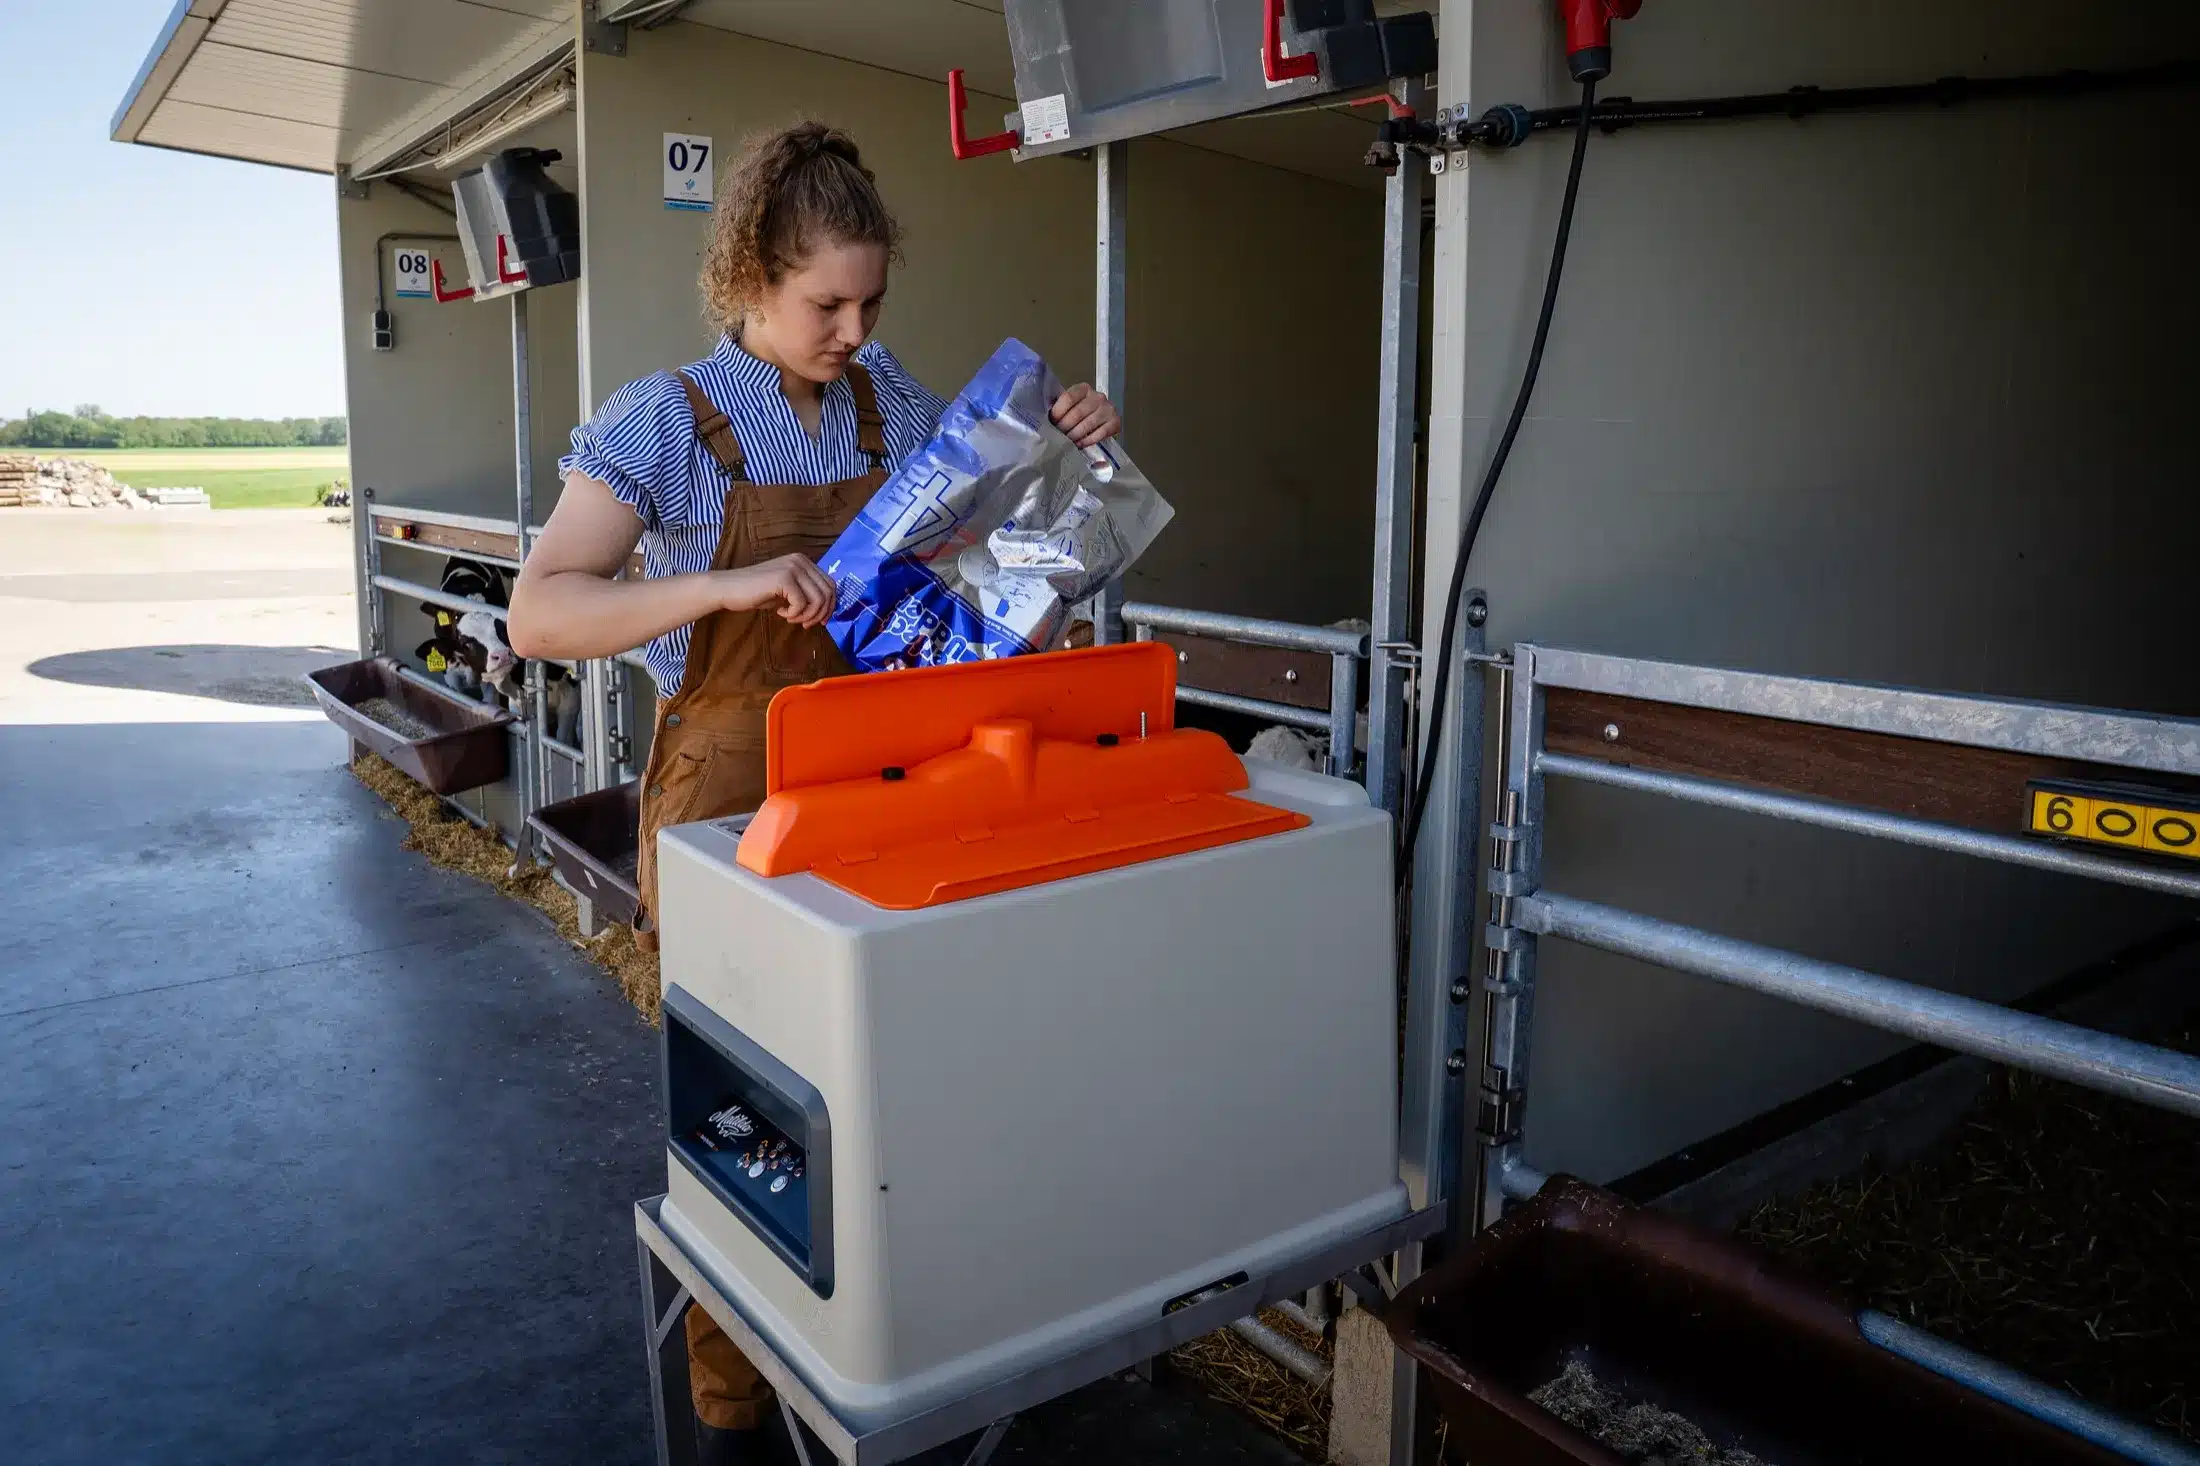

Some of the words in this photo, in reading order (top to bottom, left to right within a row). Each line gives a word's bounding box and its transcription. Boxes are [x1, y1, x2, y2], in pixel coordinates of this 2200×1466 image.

[668, 141, 709, 173] 07
[399, 254, 427, 274] 08
[877, 470, 959, 555] 4
[879, 611, 950, 667] erfect
[894, 593, 967, 662] Udder
[2046, 796, 2197, 847] 600
